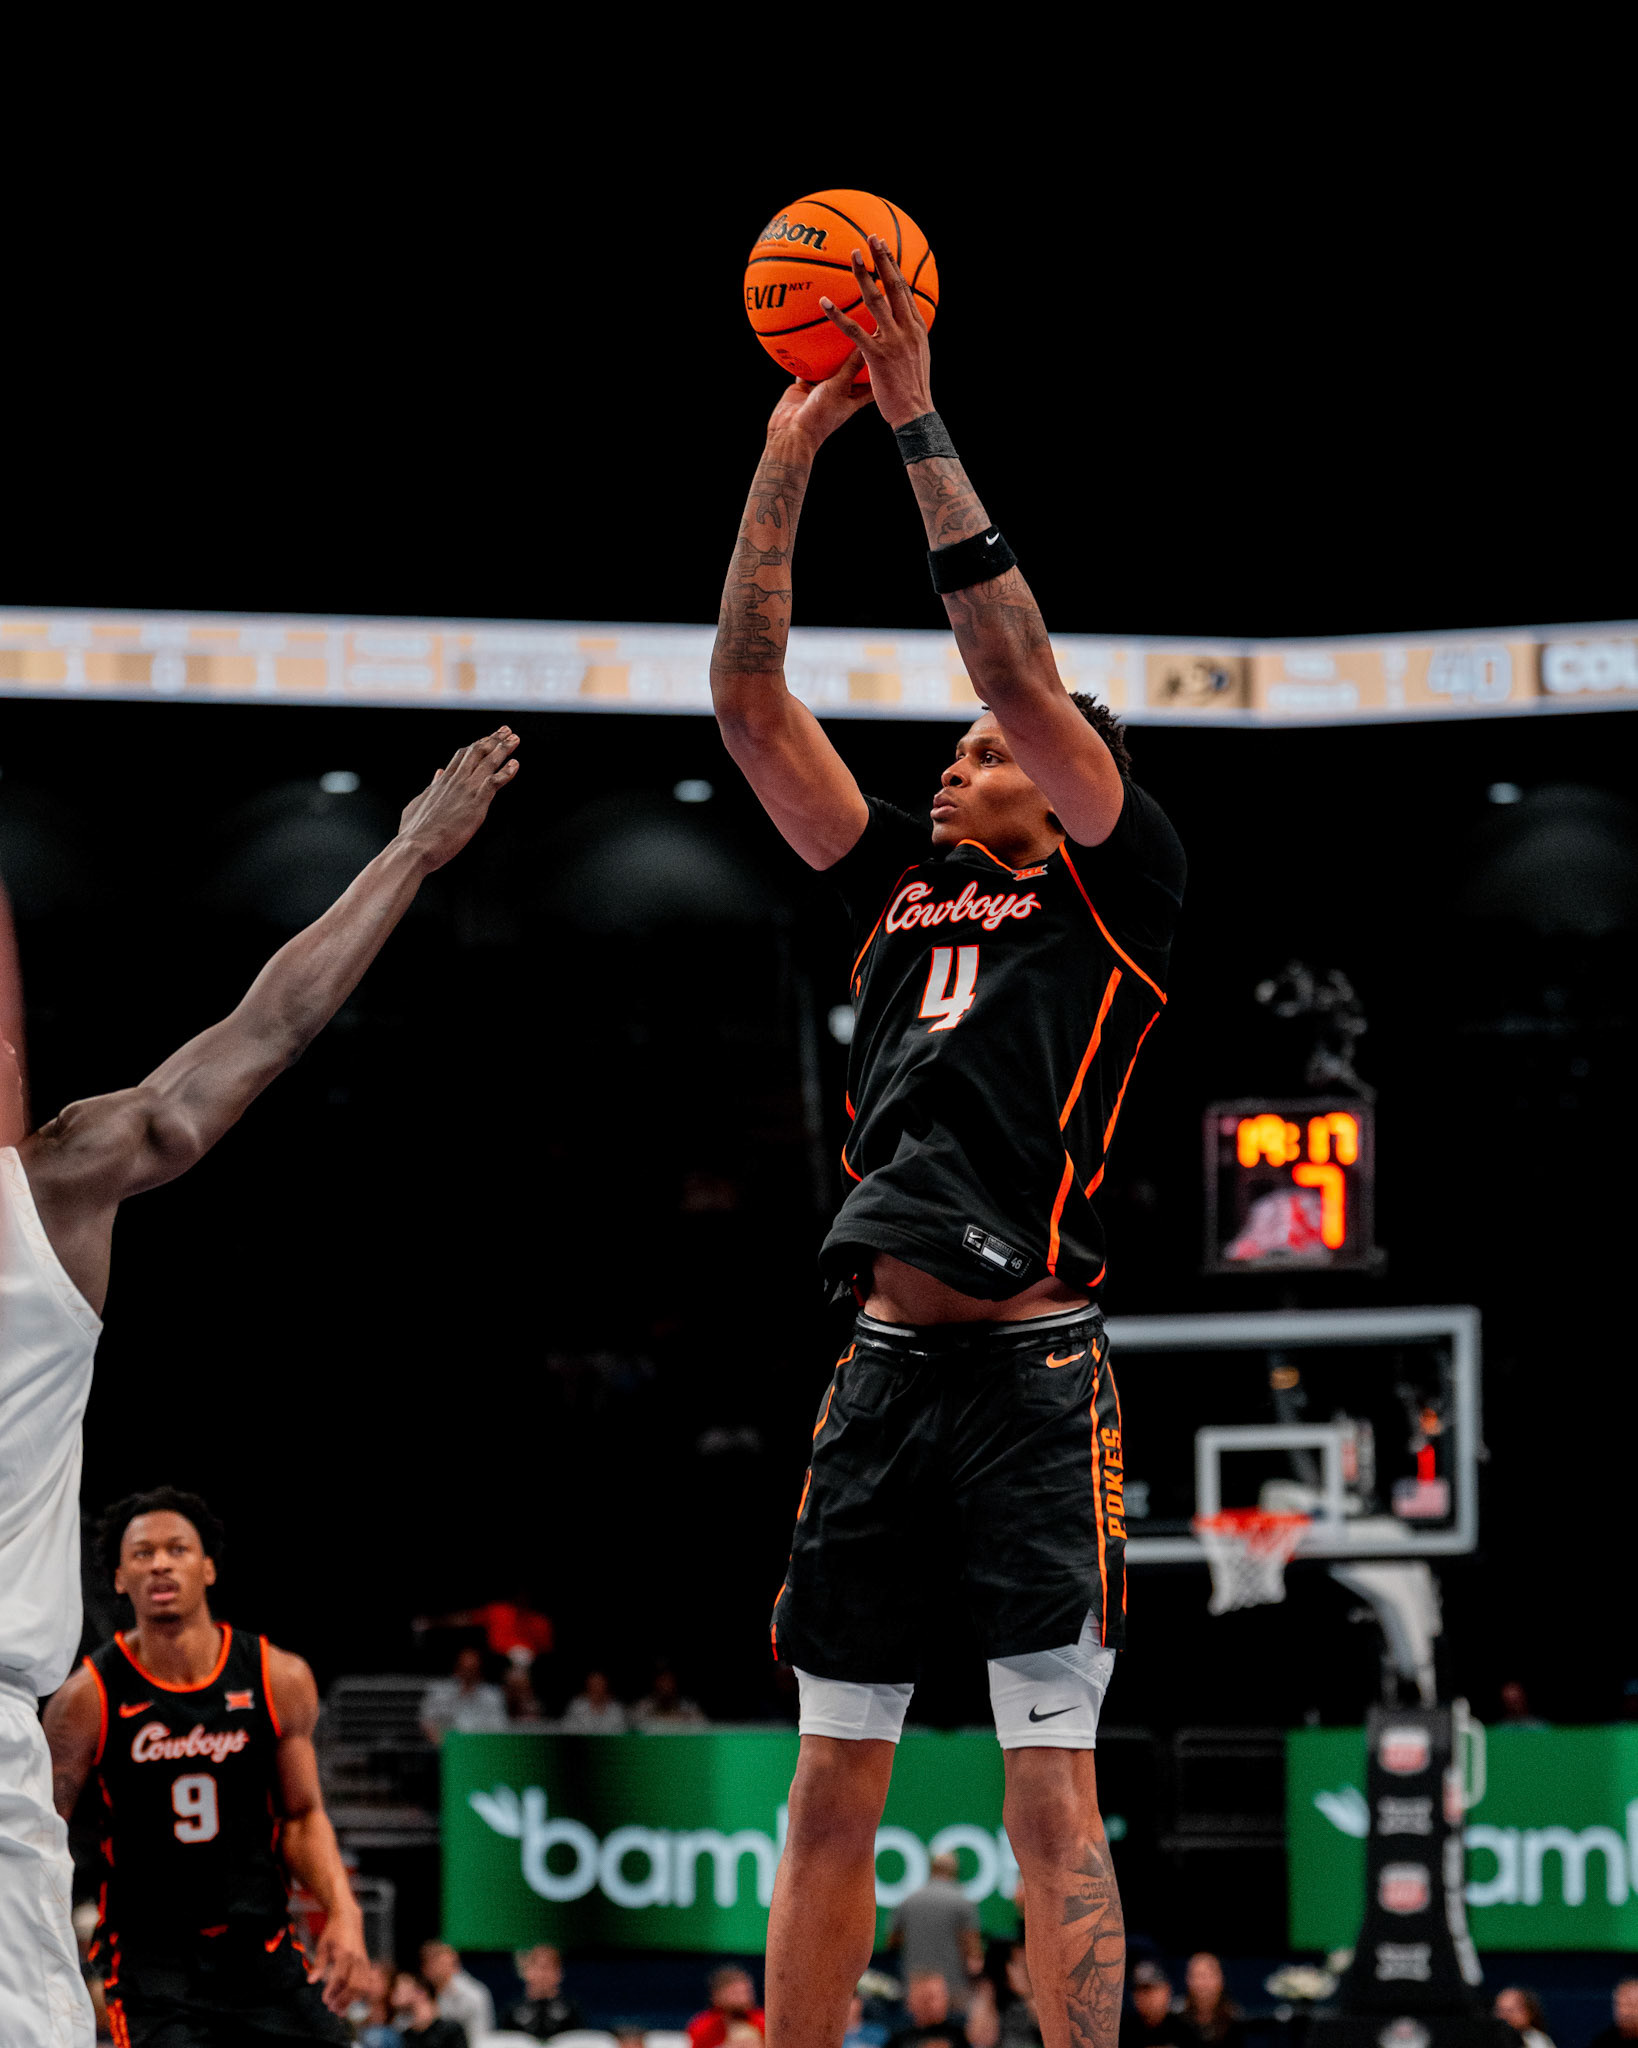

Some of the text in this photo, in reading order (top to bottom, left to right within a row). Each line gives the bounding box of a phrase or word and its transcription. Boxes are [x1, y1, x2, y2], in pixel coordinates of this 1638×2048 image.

[788, 281, 813, 292] NXT
[885, 880, 1042, 934] Cowboys
[918, 944, 980, 1034] 4
[1292, 1162, 1346, 1250] 7
[1100, 1427, 1128, 1540] POKES
[131, 1721, 249, 1764] Cowboys
[171, 1772, 220, 1844] 9
